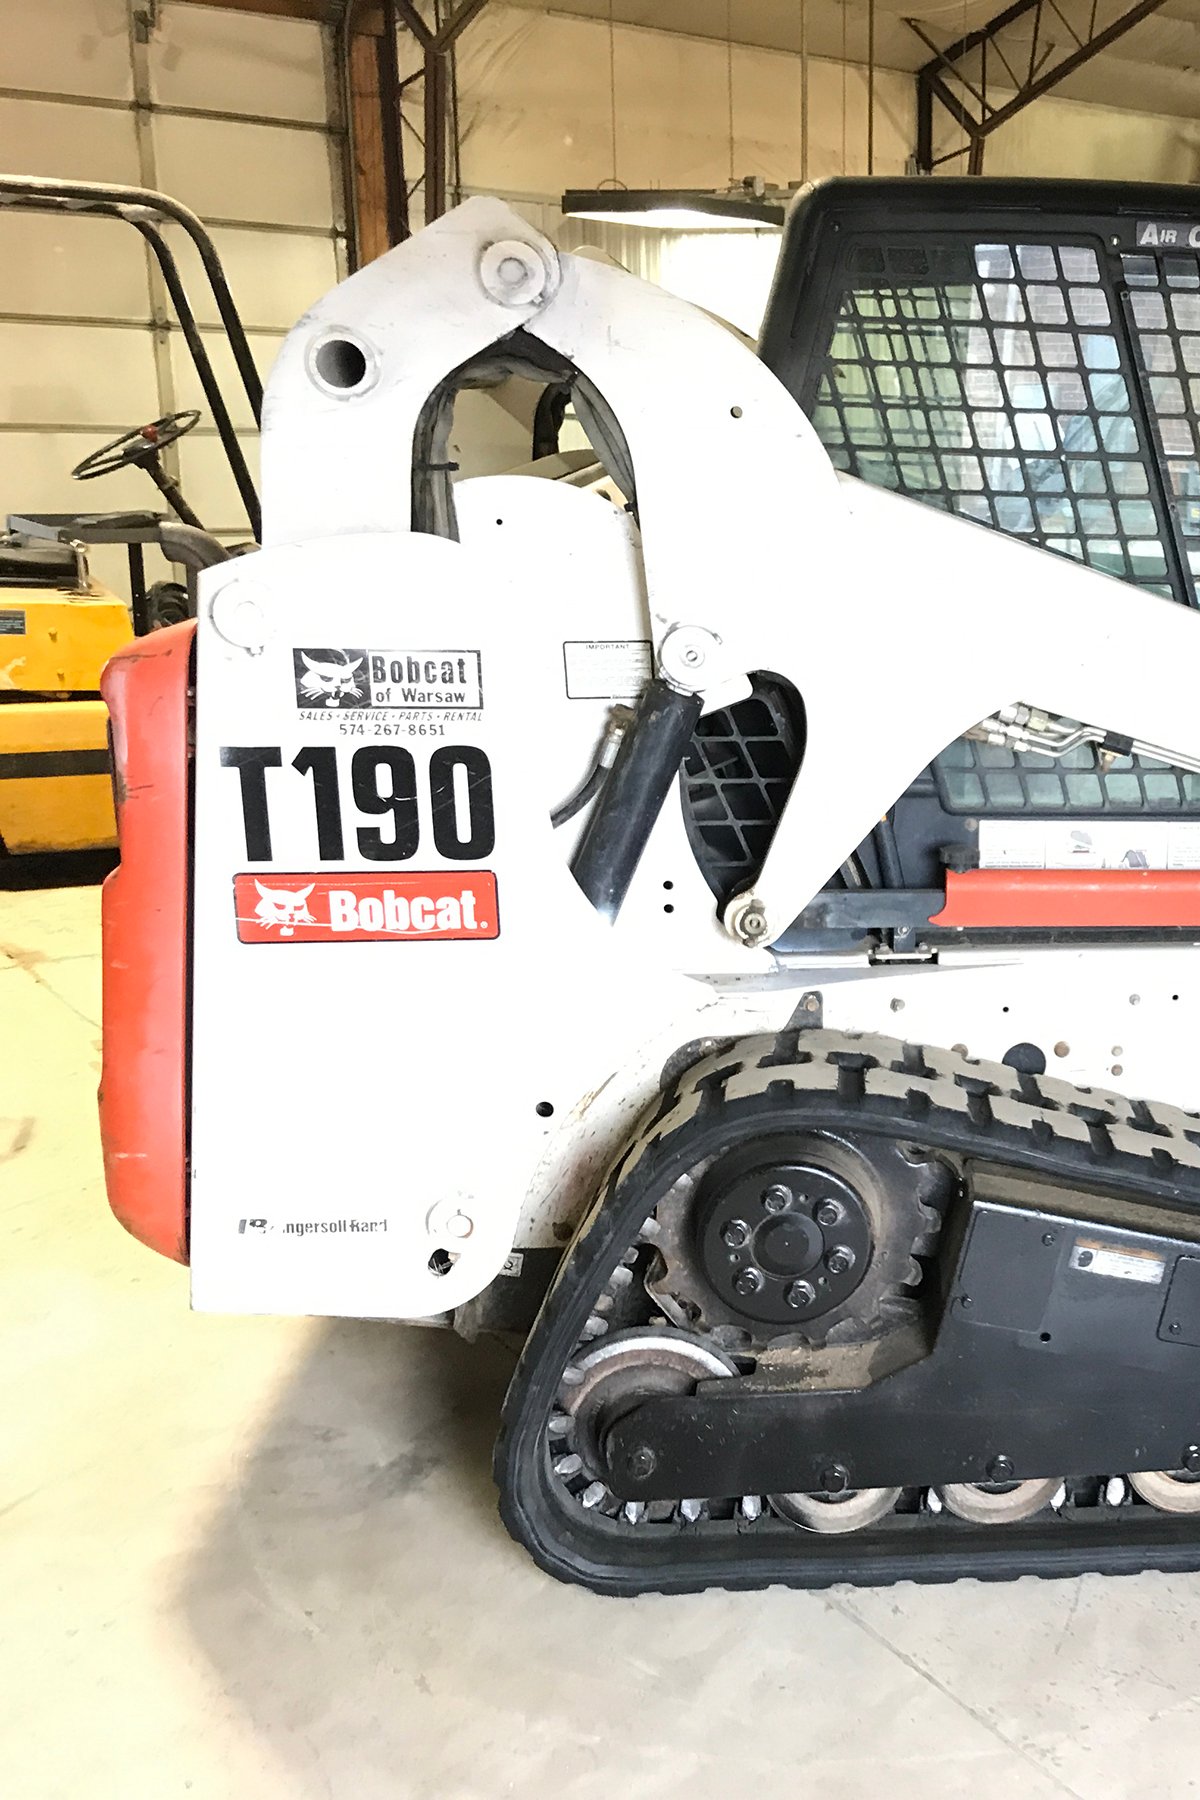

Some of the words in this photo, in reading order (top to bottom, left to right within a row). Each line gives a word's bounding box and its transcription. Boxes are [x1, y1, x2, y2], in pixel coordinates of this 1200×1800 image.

[1140, 223, 1177, 246] AIR
[371, 655, 467, 684] Bobcat
[376, 688, 392, 702] of
[402, 688, 466, 703] Warsaw
[299, 711, 333, 721] SALES
[342, 711, 388, 721] SERVICE
[399, 711, 433, 721] PARTS
[443, 711, 483, 722] RENTAL
[339, 723, 446, 736] 574-267-8651
[219, 745, 496, 861] T190
